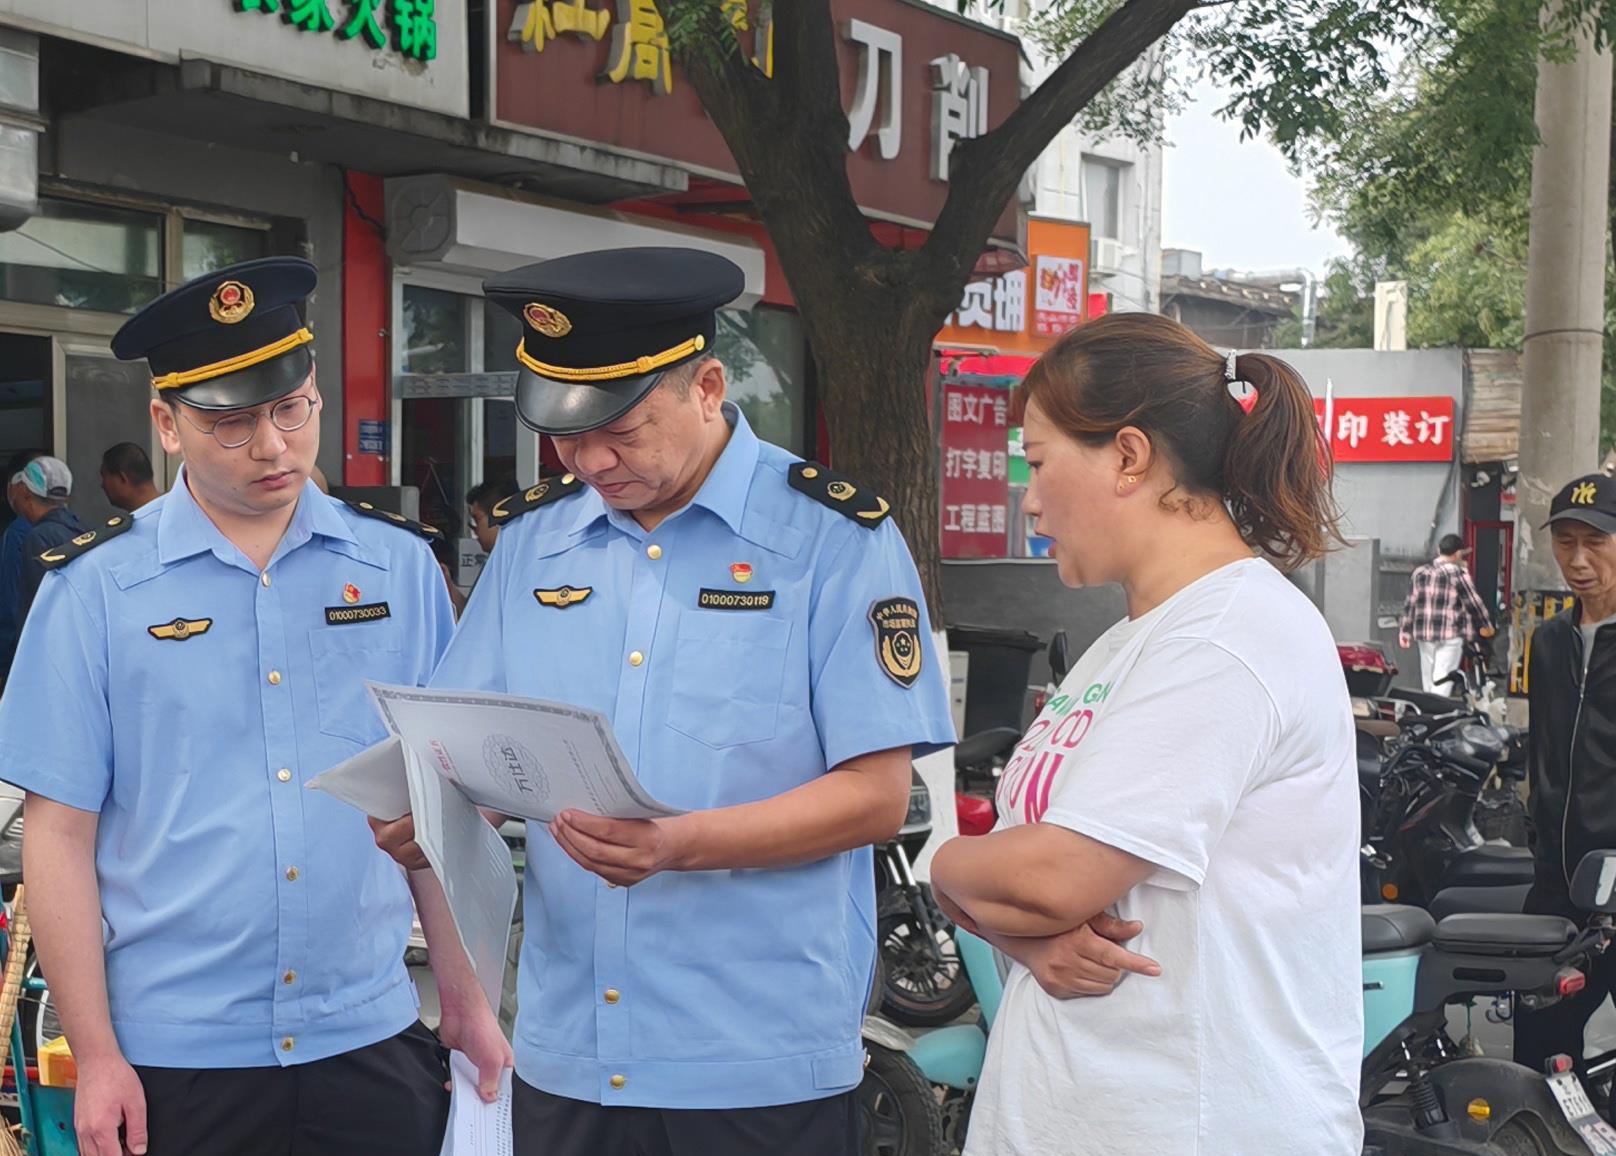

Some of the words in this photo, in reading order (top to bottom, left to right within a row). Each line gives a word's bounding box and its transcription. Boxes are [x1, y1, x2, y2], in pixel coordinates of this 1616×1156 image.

[946, 392, 1008, 426] 图文广告
[1381, 410, 1452, 446] 装订
[945, 447, 1007, 480] 打字复印
[944, 503, 1007, 534] 工程蓝图
[328, 606, 387, 621] 01000730033
[701, 592, 770, 607] 01000730119
